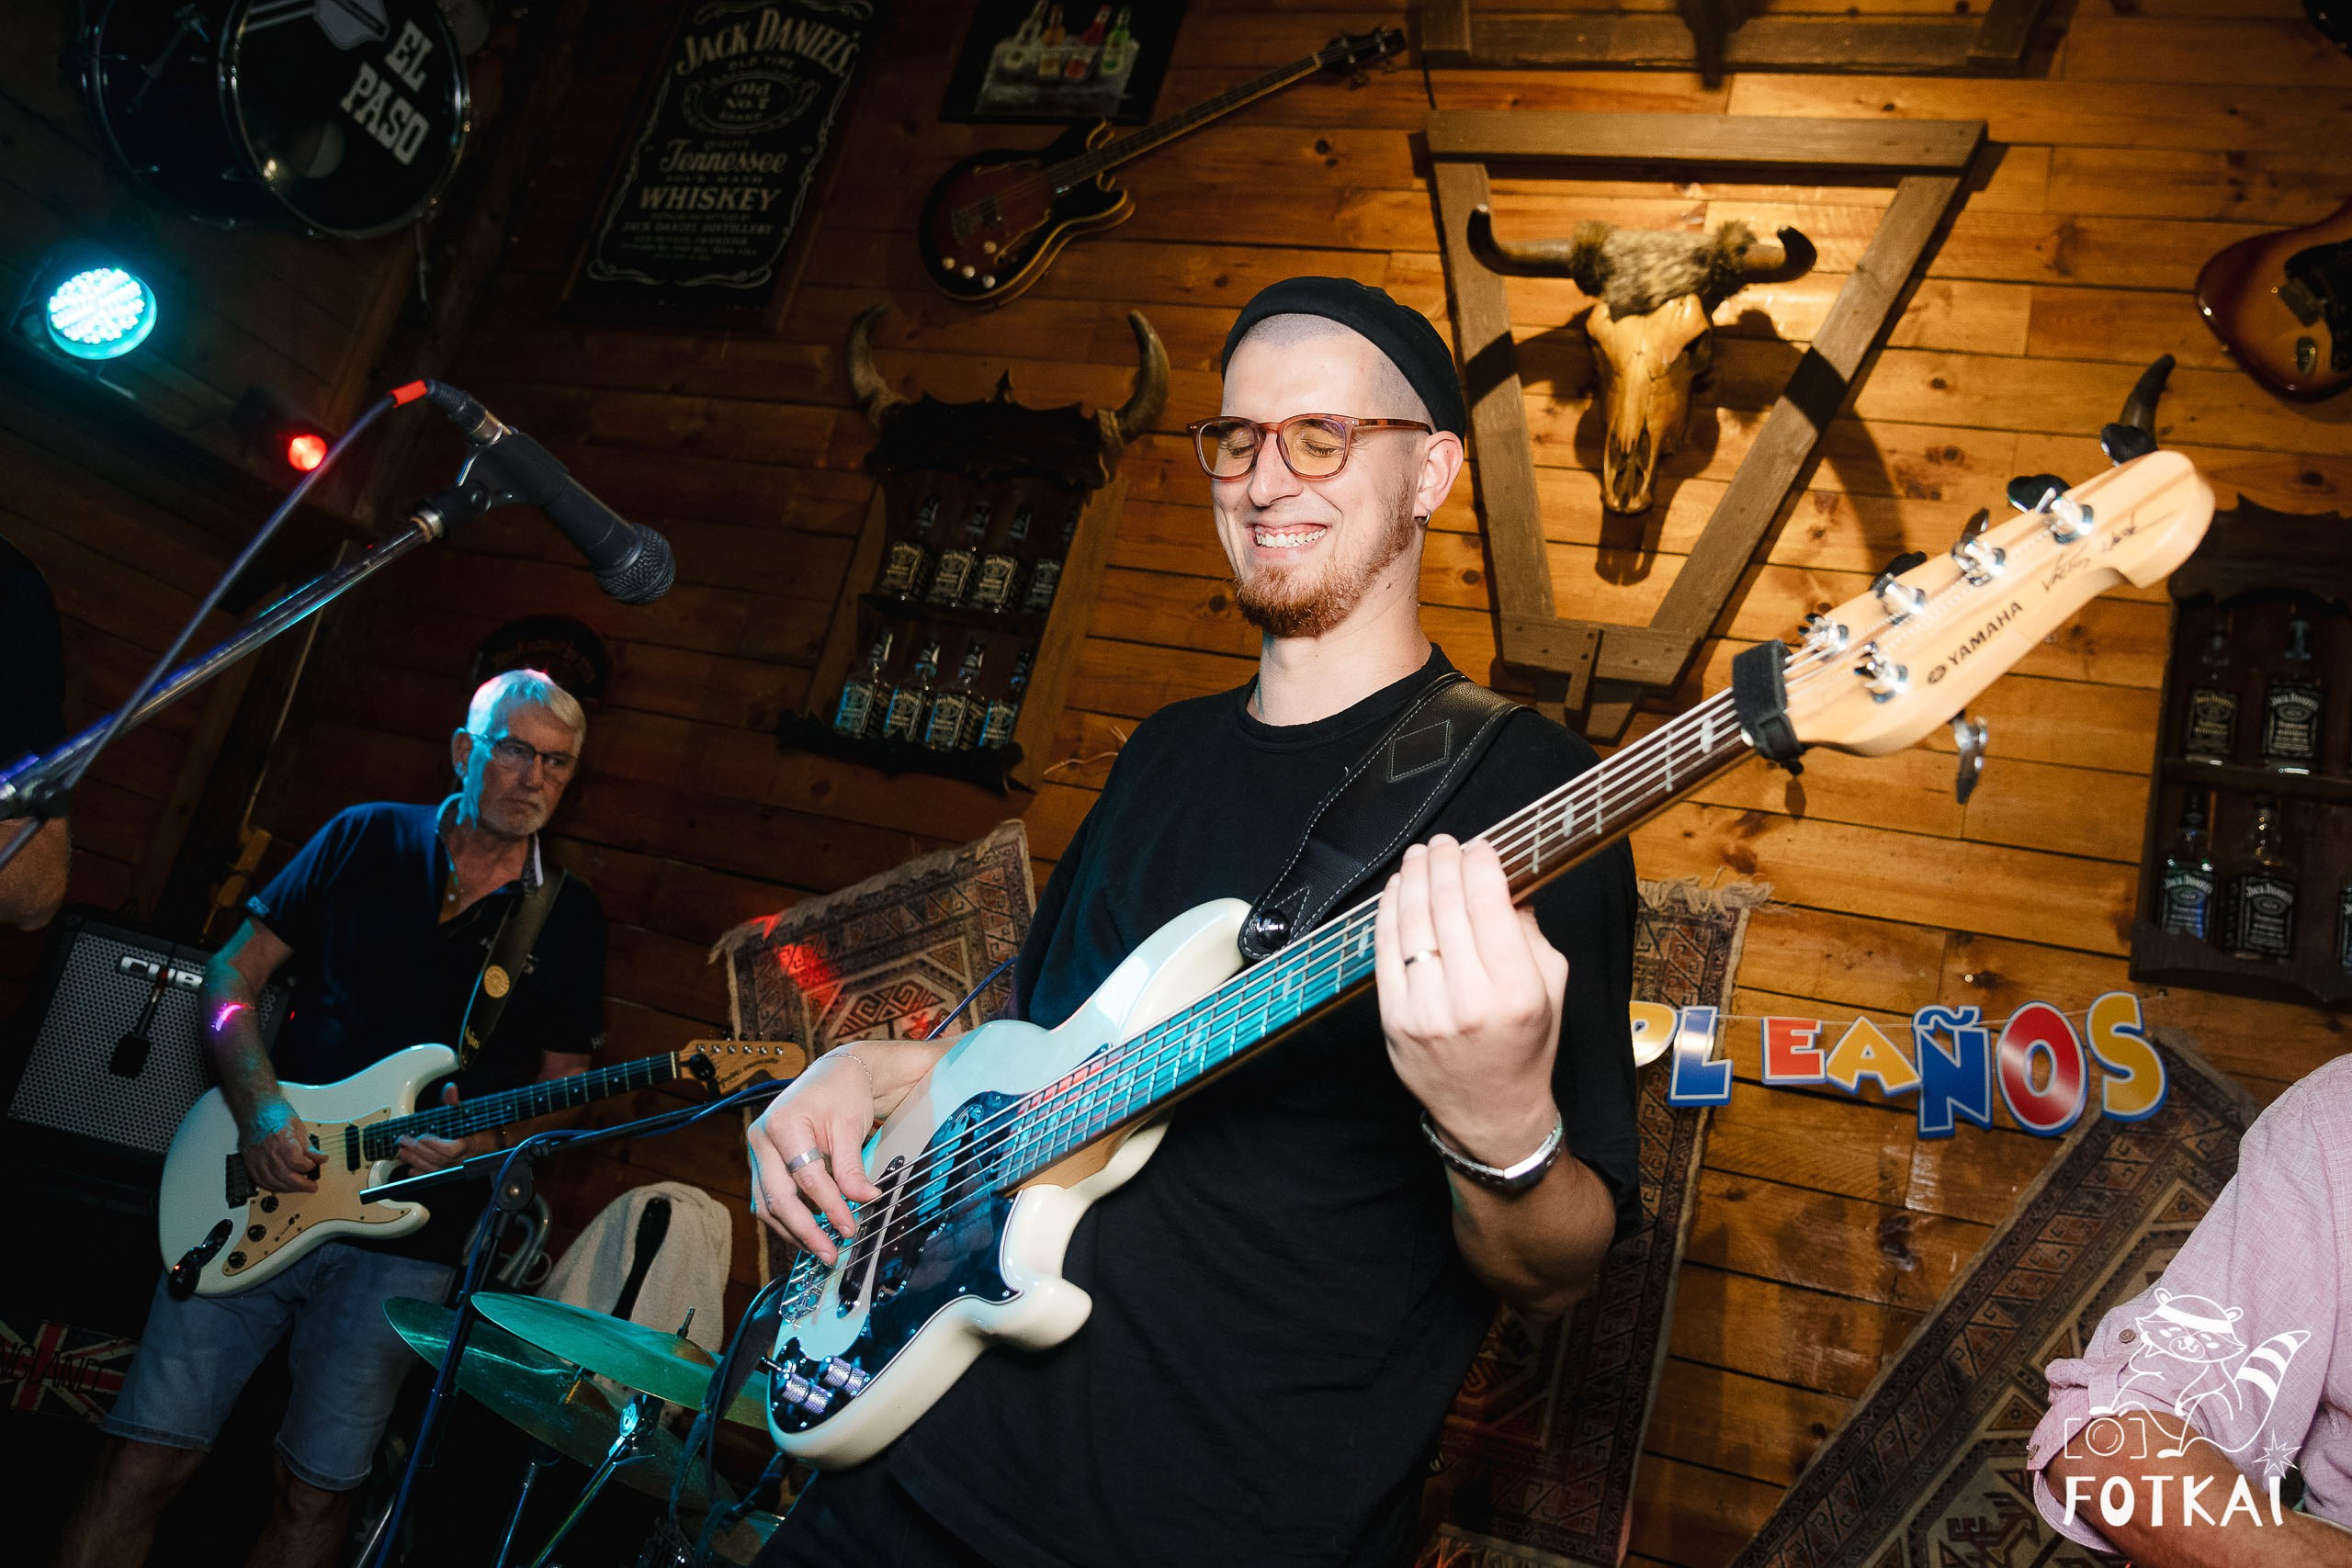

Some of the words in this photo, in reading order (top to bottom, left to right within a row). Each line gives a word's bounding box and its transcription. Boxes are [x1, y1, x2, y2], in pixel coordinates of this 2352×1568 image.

[384, 18, 434, 93] EL
[676, 21, 751, 76] JACK
[340, 61, 431, 165] PASO
[660, 137, 788, 175] Tennessee
[639, 185, 782, 211] WHISKEY
[1948, 600, 2023, 665] YAMAHA
